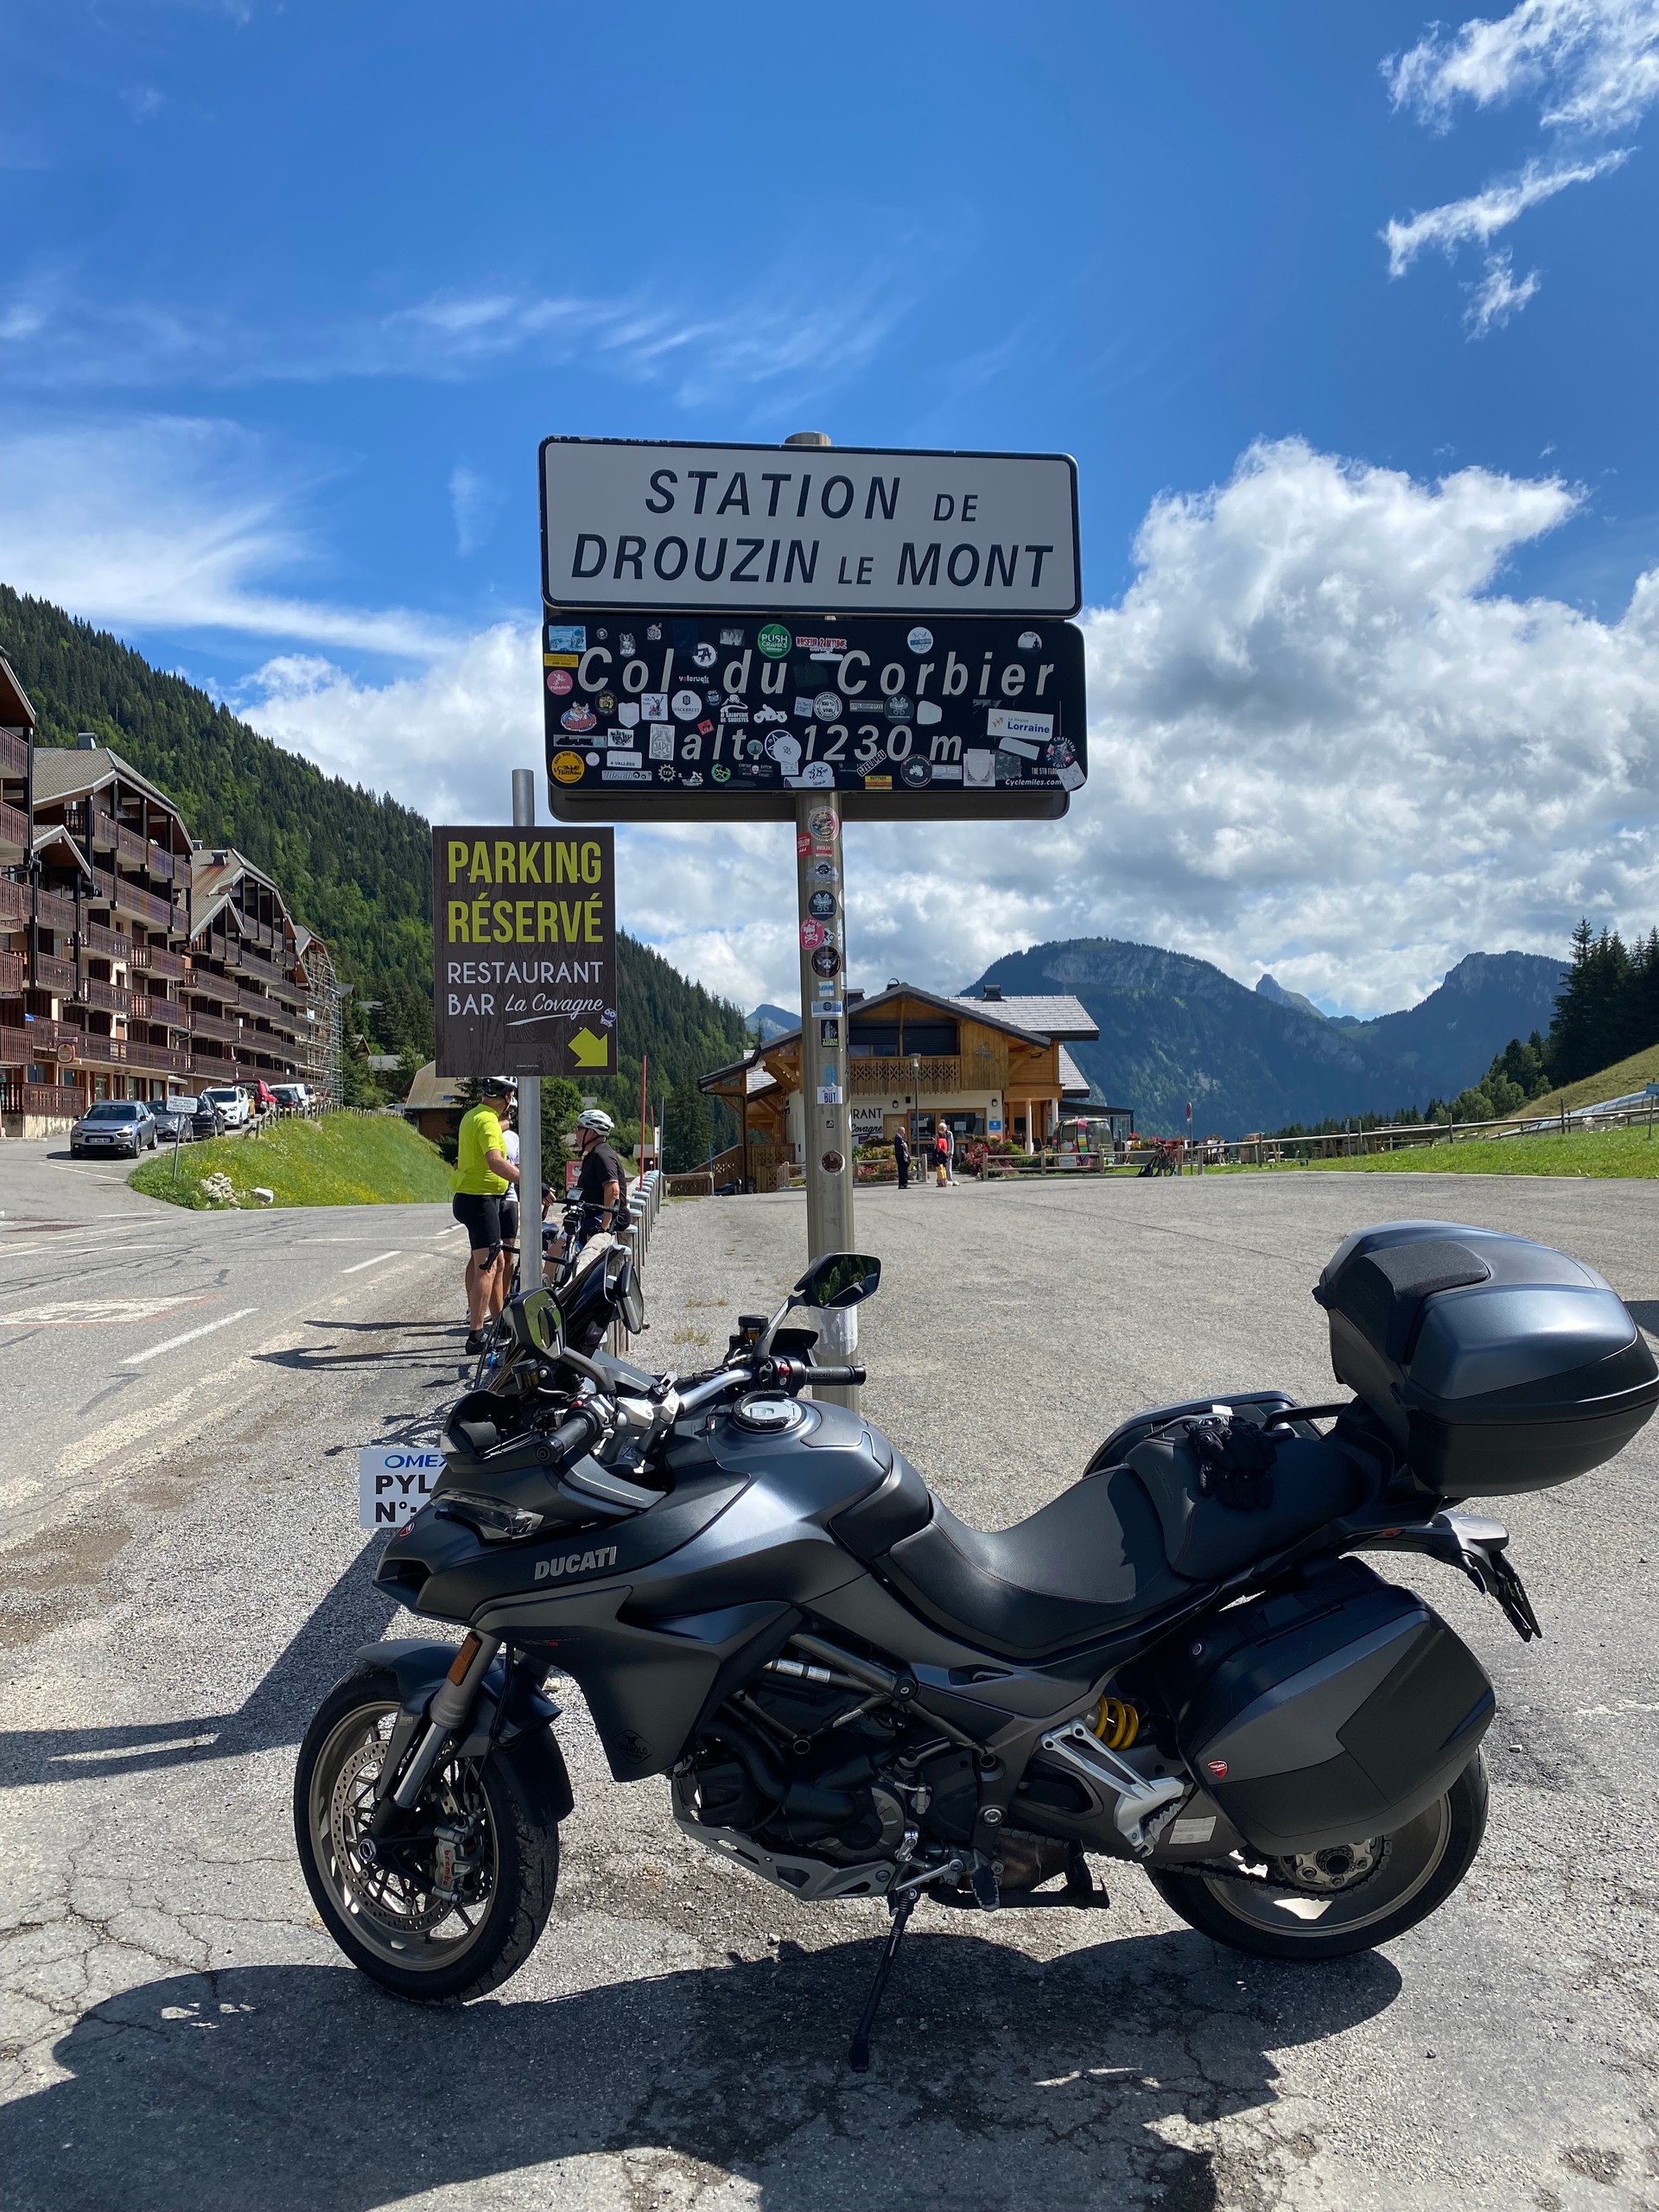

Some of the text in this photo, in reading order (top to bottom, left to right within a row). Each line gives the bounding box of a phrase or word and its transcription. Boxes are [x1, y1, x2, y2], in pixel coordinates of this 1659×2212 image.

[645, 469, 979, 523] STATION DE
[571, 533, 1055, 588] DROUZIN LE MONT
[761, 633, 788, 643] PUSH
[577, 645, 1055, 696] Col du Corbier
[681, 724, 963, 761] alt. 1230 m
[1007, 721, 1051, 734] Lorraine
[653, 741, 671, 753] JAPE
[448, 841, 601, 884] PARKING
[448, 893, 604, 943] RÉSERVÉ
[448, 962, 604, 984] RESTAURANT
[448, 993, 604, 1020] BAR La Covagne
[385, 1453, 448, 1469] OMEX
[375, 1474, 433, 1495] PYL
[534, 1546, 617, 1580] DUCATI
[442, 1848, 451, 1886] brembo
